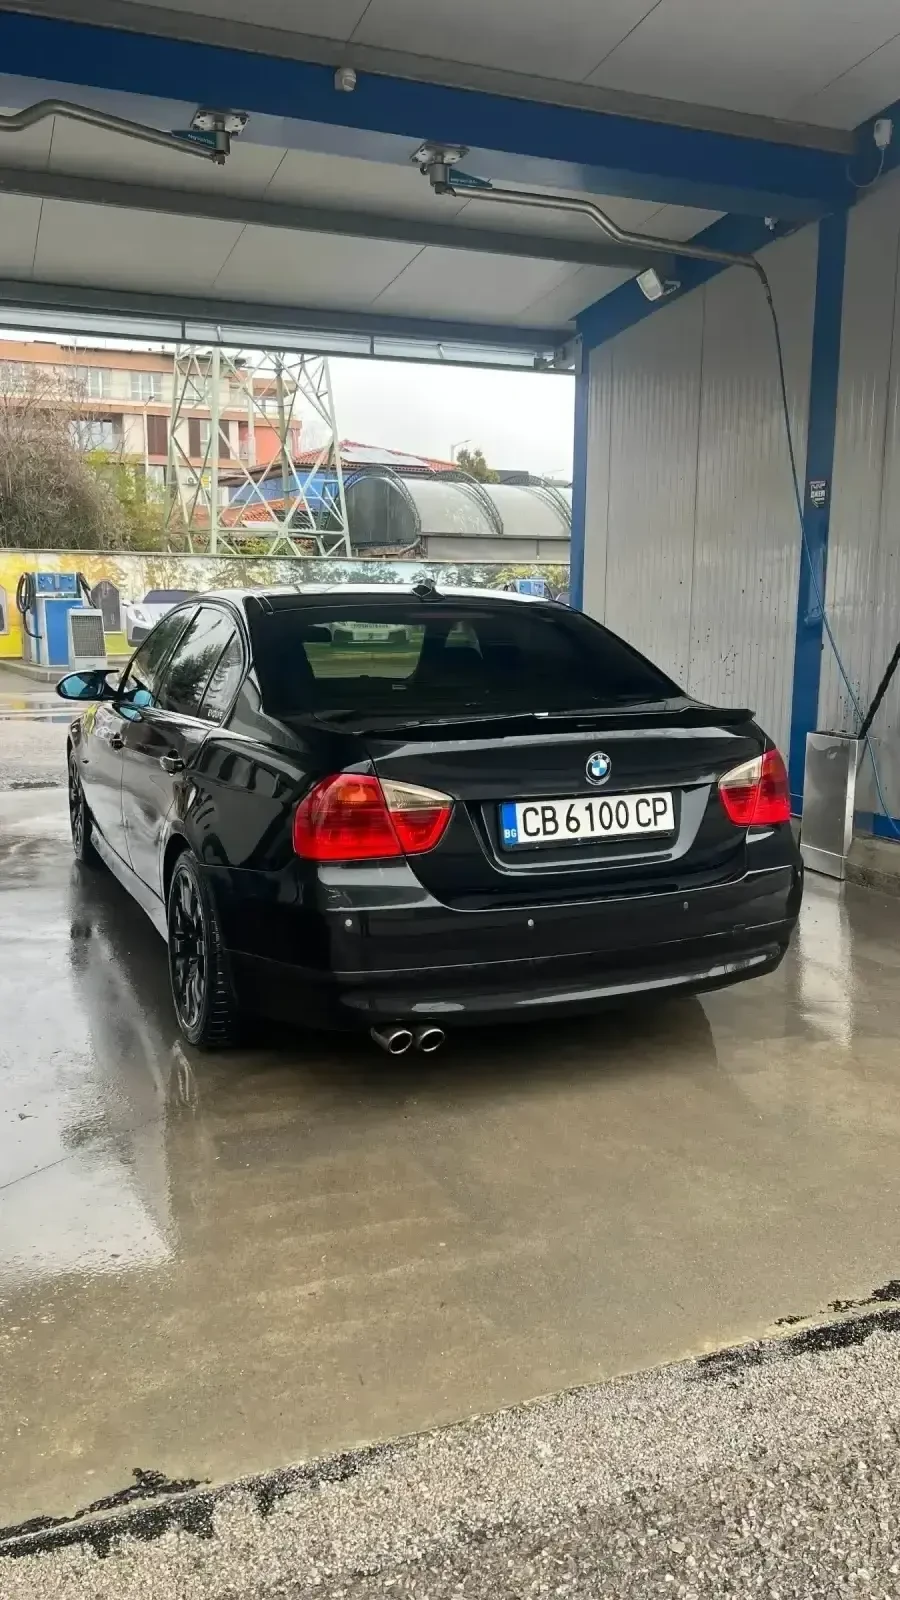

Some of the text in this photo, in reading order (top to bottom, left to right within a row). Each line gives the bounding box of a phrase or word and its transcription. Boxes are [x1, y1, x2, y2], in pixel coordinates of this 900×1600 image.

[522, 797, 668, 837] CB 6100 CP
[503, 829, 517, 839] BG
